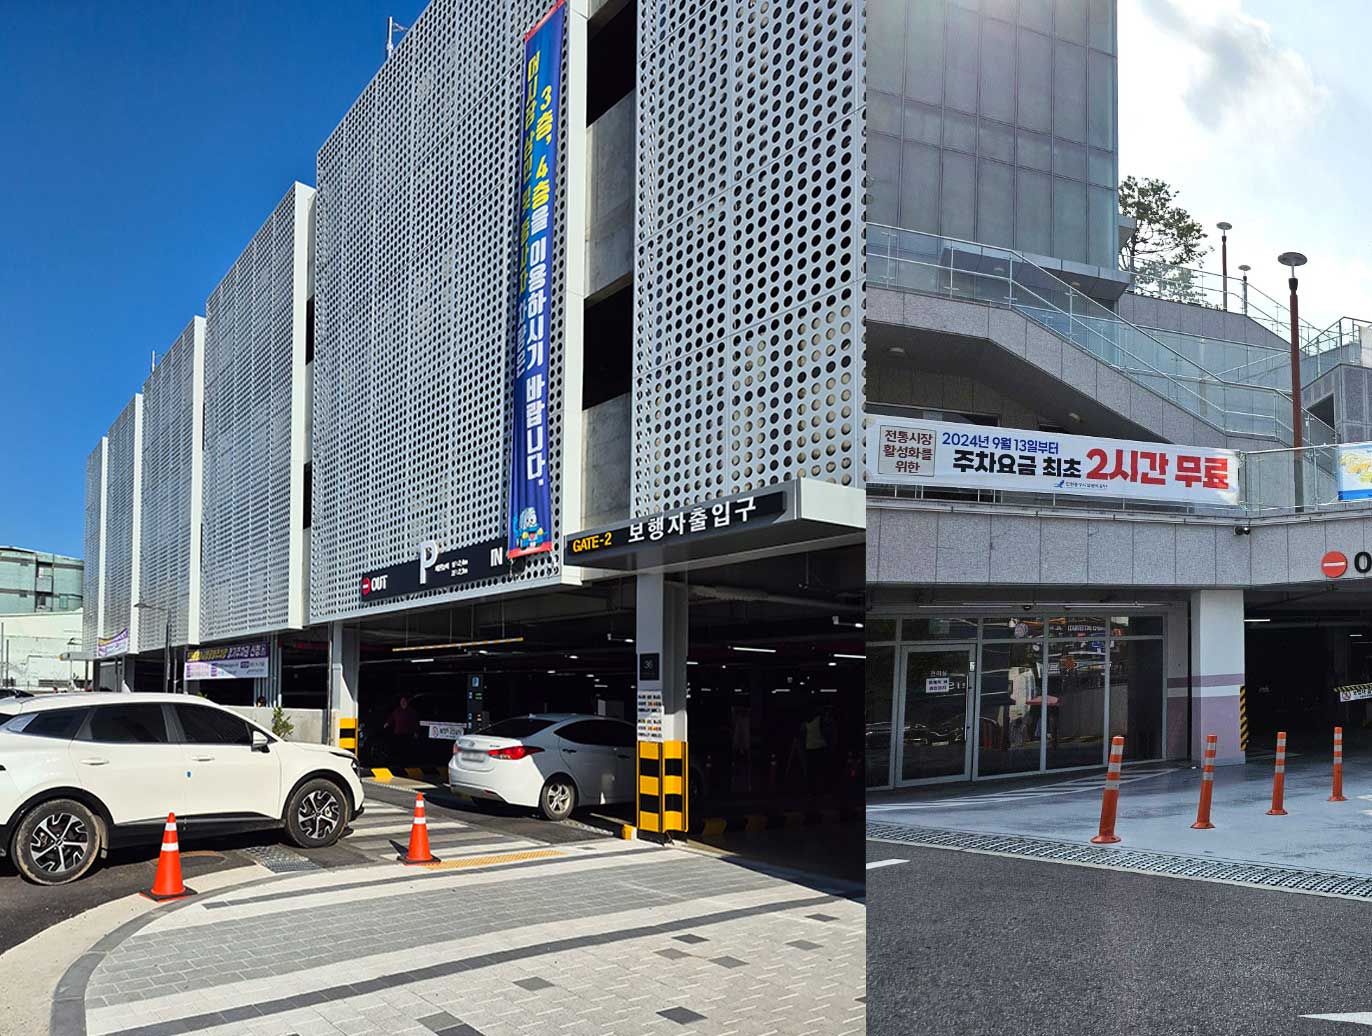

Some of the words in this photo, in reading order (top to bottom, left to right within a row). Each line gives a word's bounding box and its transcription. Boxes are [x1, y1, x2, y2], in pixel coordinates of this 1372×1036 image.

[536, 85, 553, 145] 3층,
[531, 155, 551, 236] 4층을
[527, 237, 547, 371] 이용하시기
[526, 374, 545, 486] 바랍니다.
[883, 443, 933, 461] 활성화를
[884, 429, 932, 446] 전통시장
[942, 432, 990, 450] 2024년
[992, 436, 1012, 452] 9월
[1013, 438, 1060, 455] 13일부터
[895, 460, 921, 474] 위한
[953, 449, 1038, 477] 주차요금
[1042, 455, 1082, 479] 최초
[1085, 448, 1169, 486] 2시간
[1174, 454, 1230, 490] 무료
[627, 495, 758, 543] 보행자출입구
[371, 575, 388, 591] OUT
[419, 539, 438, 584] P
[490, 547, 503, 567] IN
[572, 532, 612, 554] GATE-2
